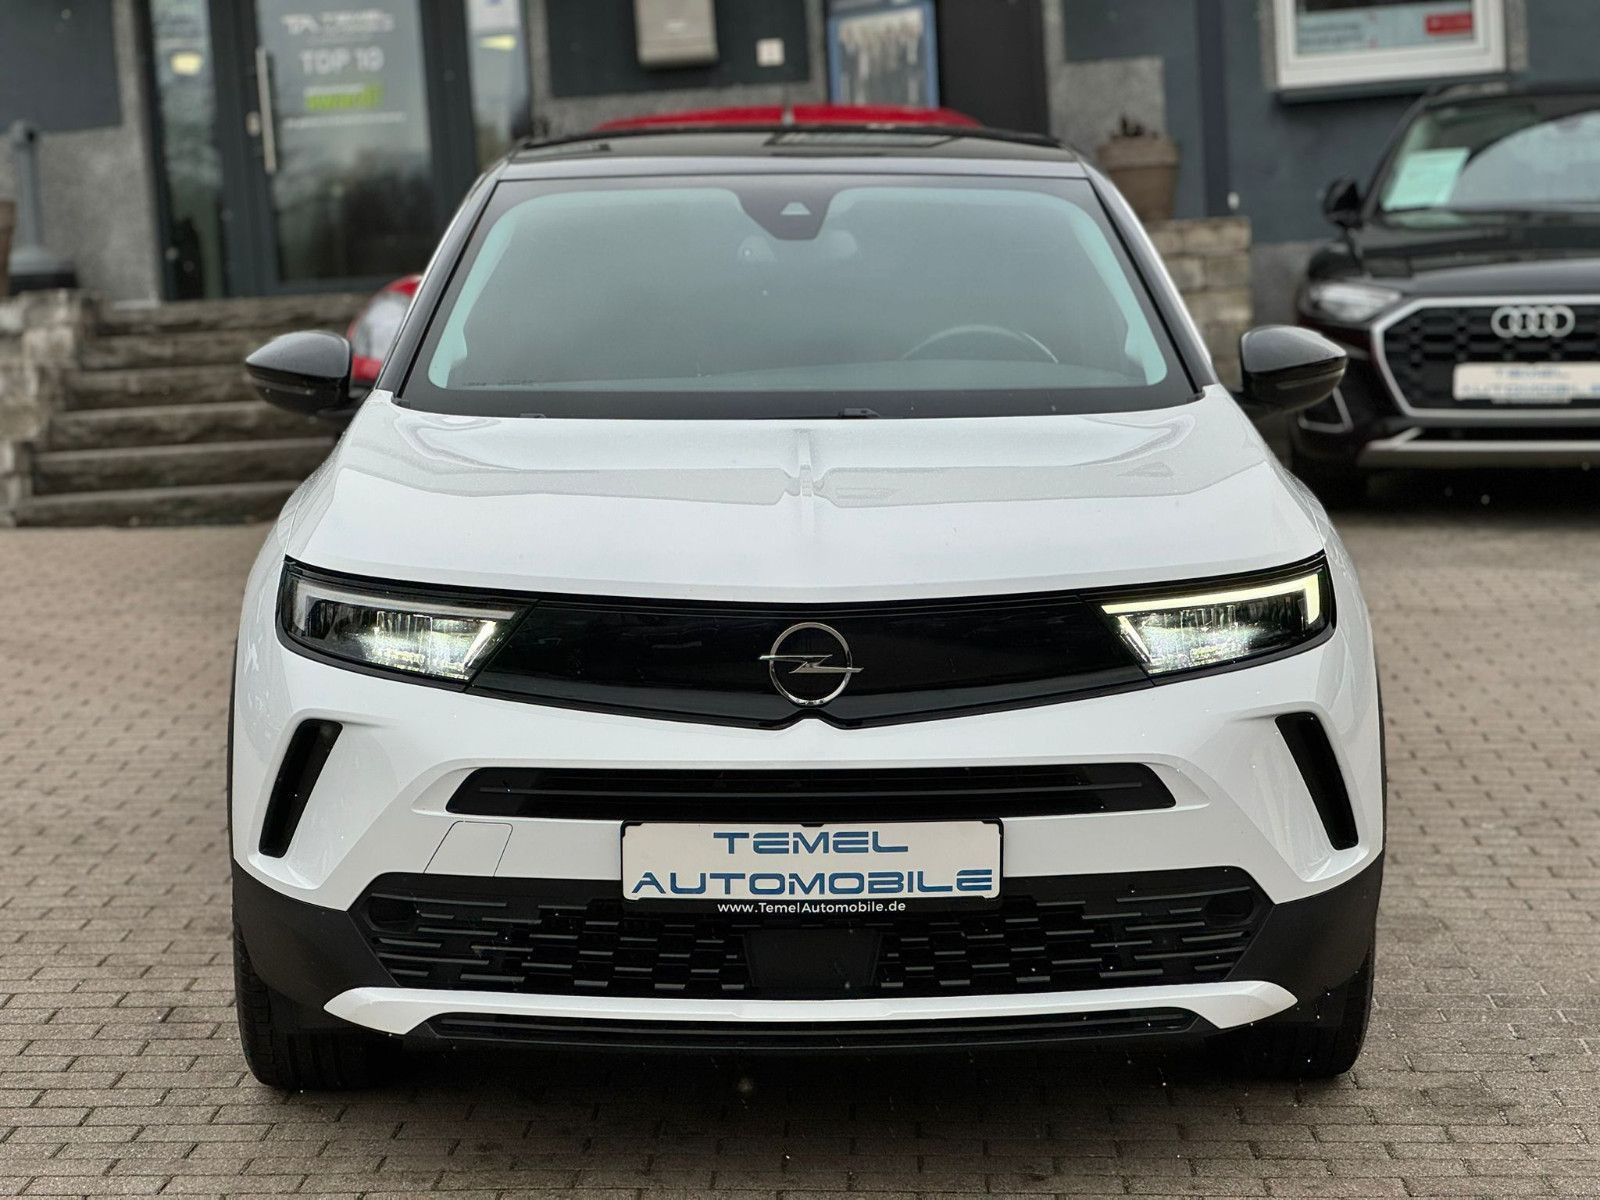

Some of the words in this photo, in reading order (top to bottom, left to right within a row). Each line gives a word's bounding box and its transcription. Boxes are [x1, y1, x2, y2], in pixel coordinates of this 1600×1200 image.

[300, 50, 349, 75] TOP
[713, 831, 909, 855] TEMEL
[631, 869, 993, 896] AUTOMOBILE
[717, 901, 907, 914] www.TemelAutomobile.de
